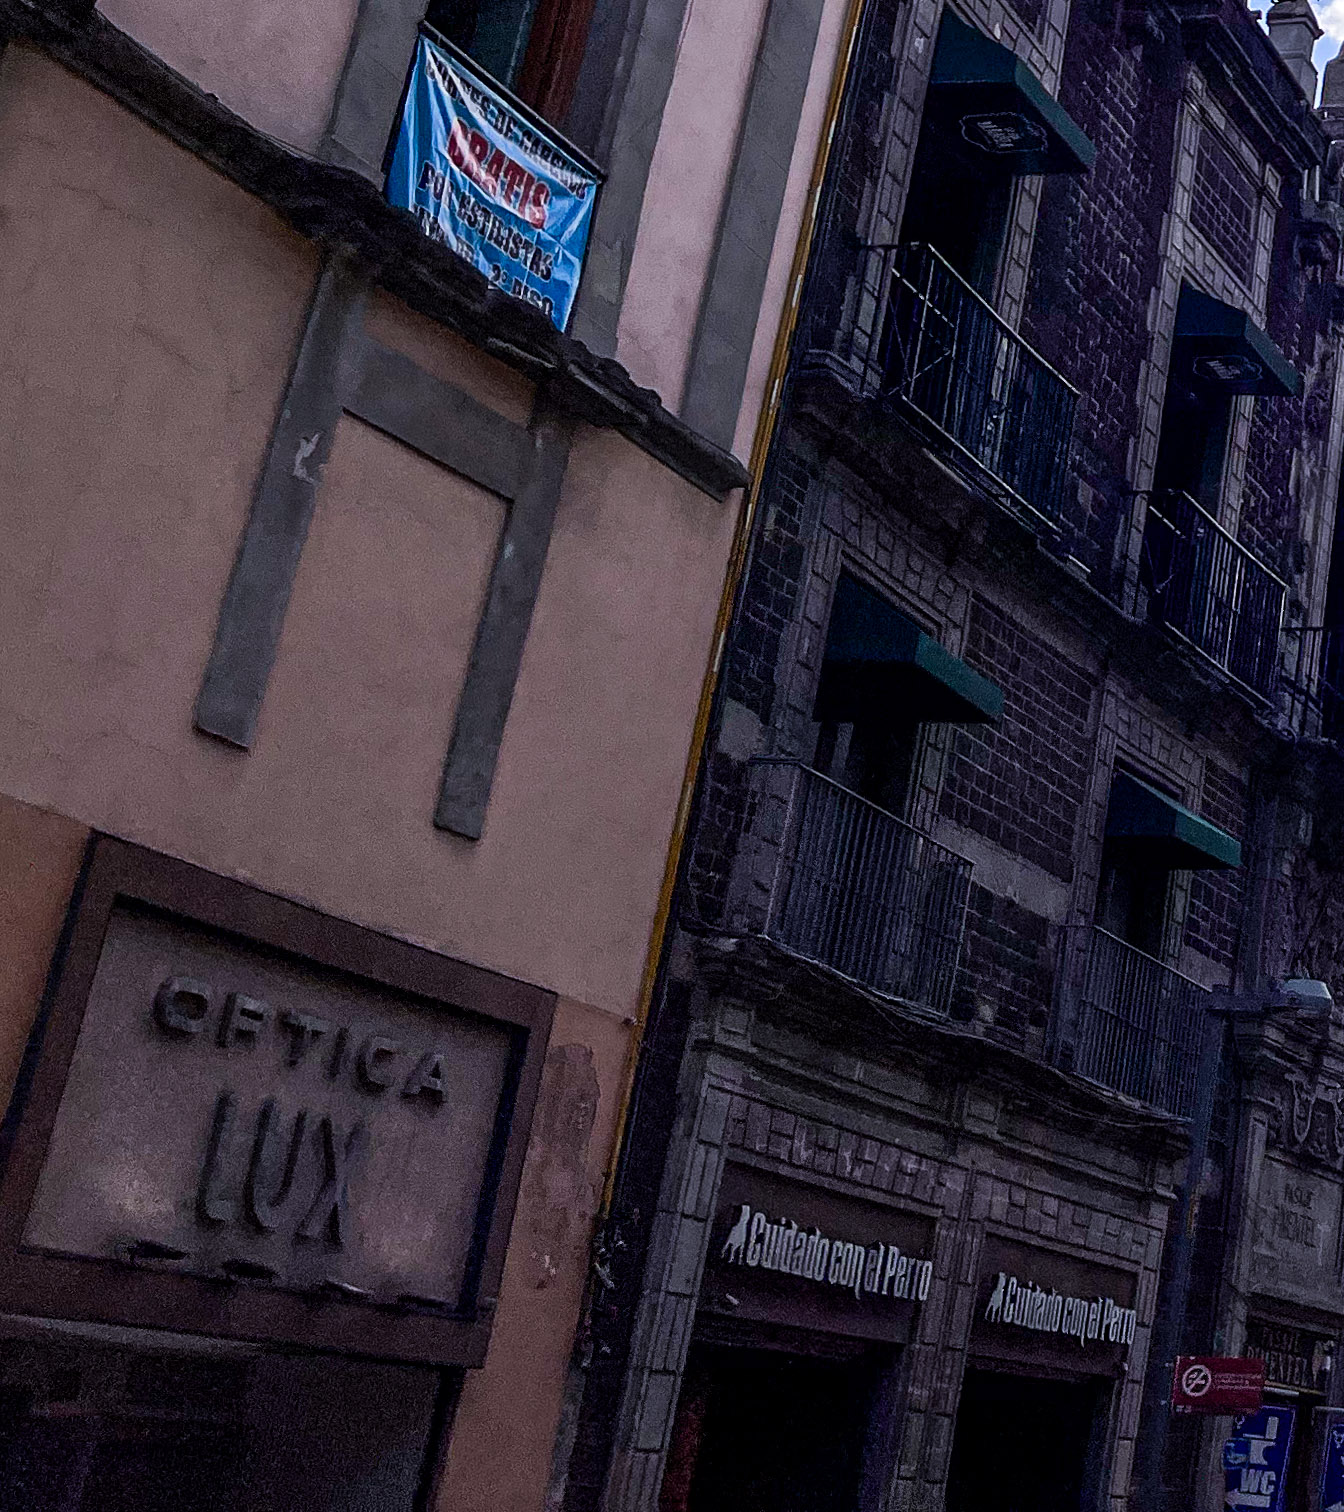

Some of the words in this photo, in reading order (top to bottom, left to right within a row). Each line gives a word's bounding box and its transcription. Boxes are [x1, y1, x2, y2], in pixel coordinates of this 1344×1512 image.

[448, 116, 550, 230] GRATIS
[200, 1090, 369, 1248] LUX
[746, 1212, 830, 1281] Cuidado
[828, 1240, 865, 1300] con
[864, 1241, 885, 1294] el
[881, 1245, 933, 1301] Perro
[1003, 1276, 1063, 1332] Cuidado
[1061, 1297, 1089, 1348] con
[1087, 1296, 1103, 1339] el
[1100, 1297, 1137, 1345] Perro
[1240, 1469, 1277, 1494] WC
